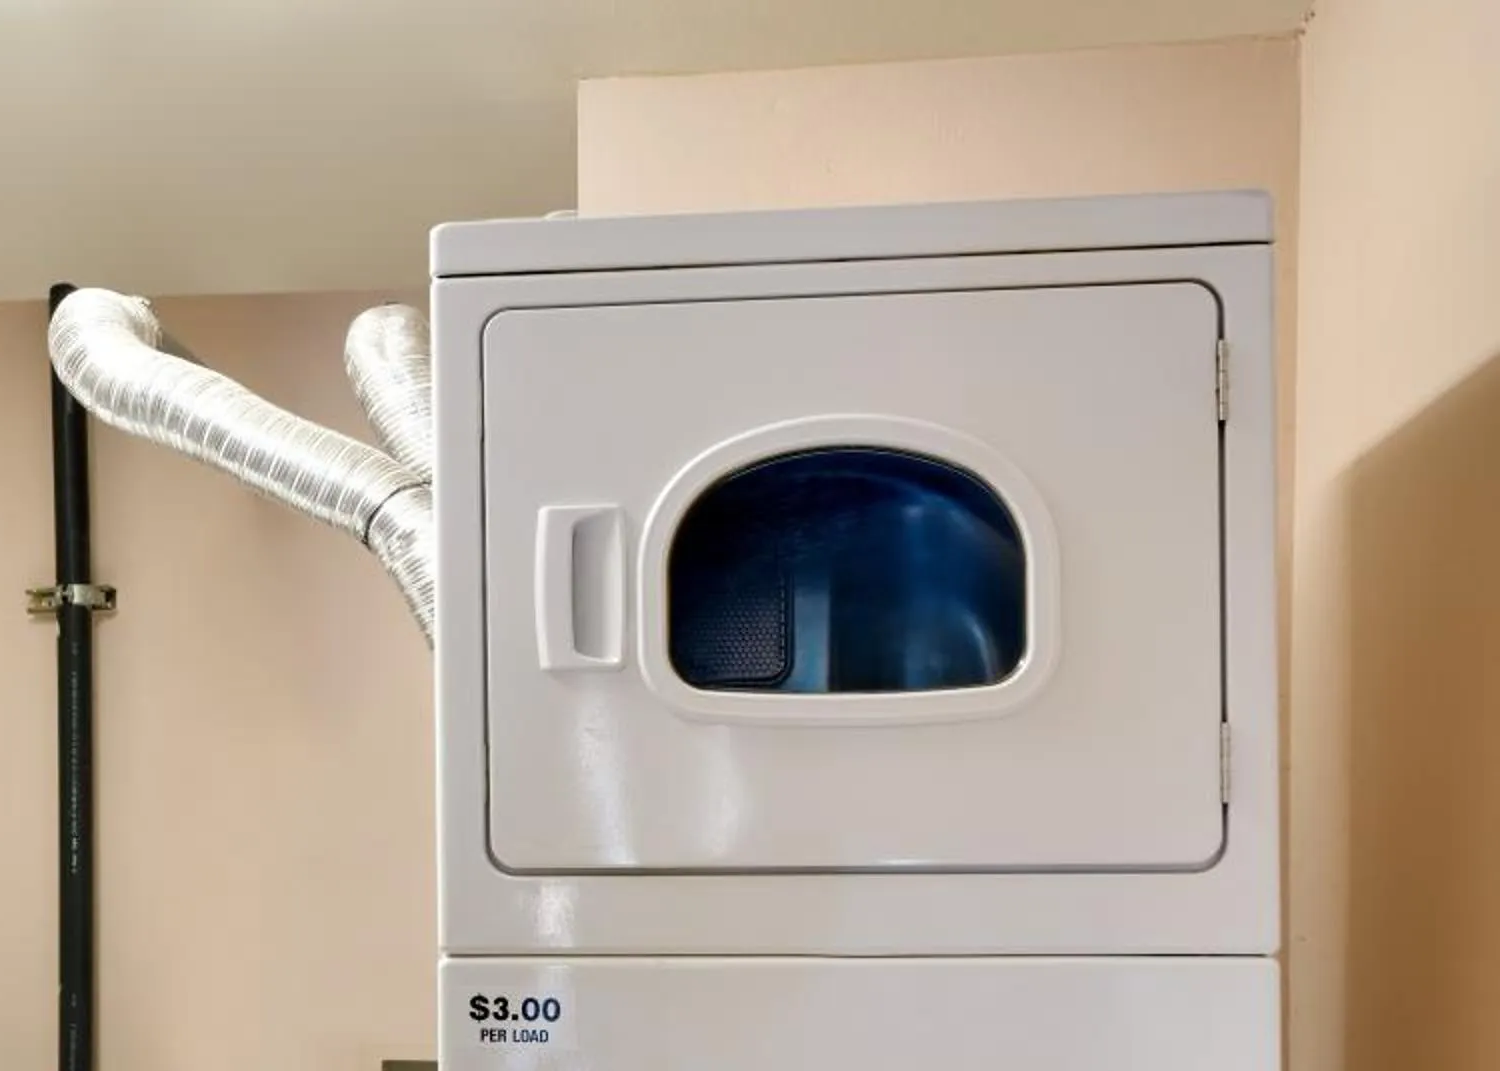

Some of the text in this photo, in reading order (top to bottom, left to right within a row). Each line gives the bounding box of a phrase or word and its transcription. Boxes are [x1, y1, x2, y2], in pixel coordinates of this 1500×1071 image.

[468, 993, 561, 1022] $3.00
[481, 1028, 549, 1043] PER LOAD
